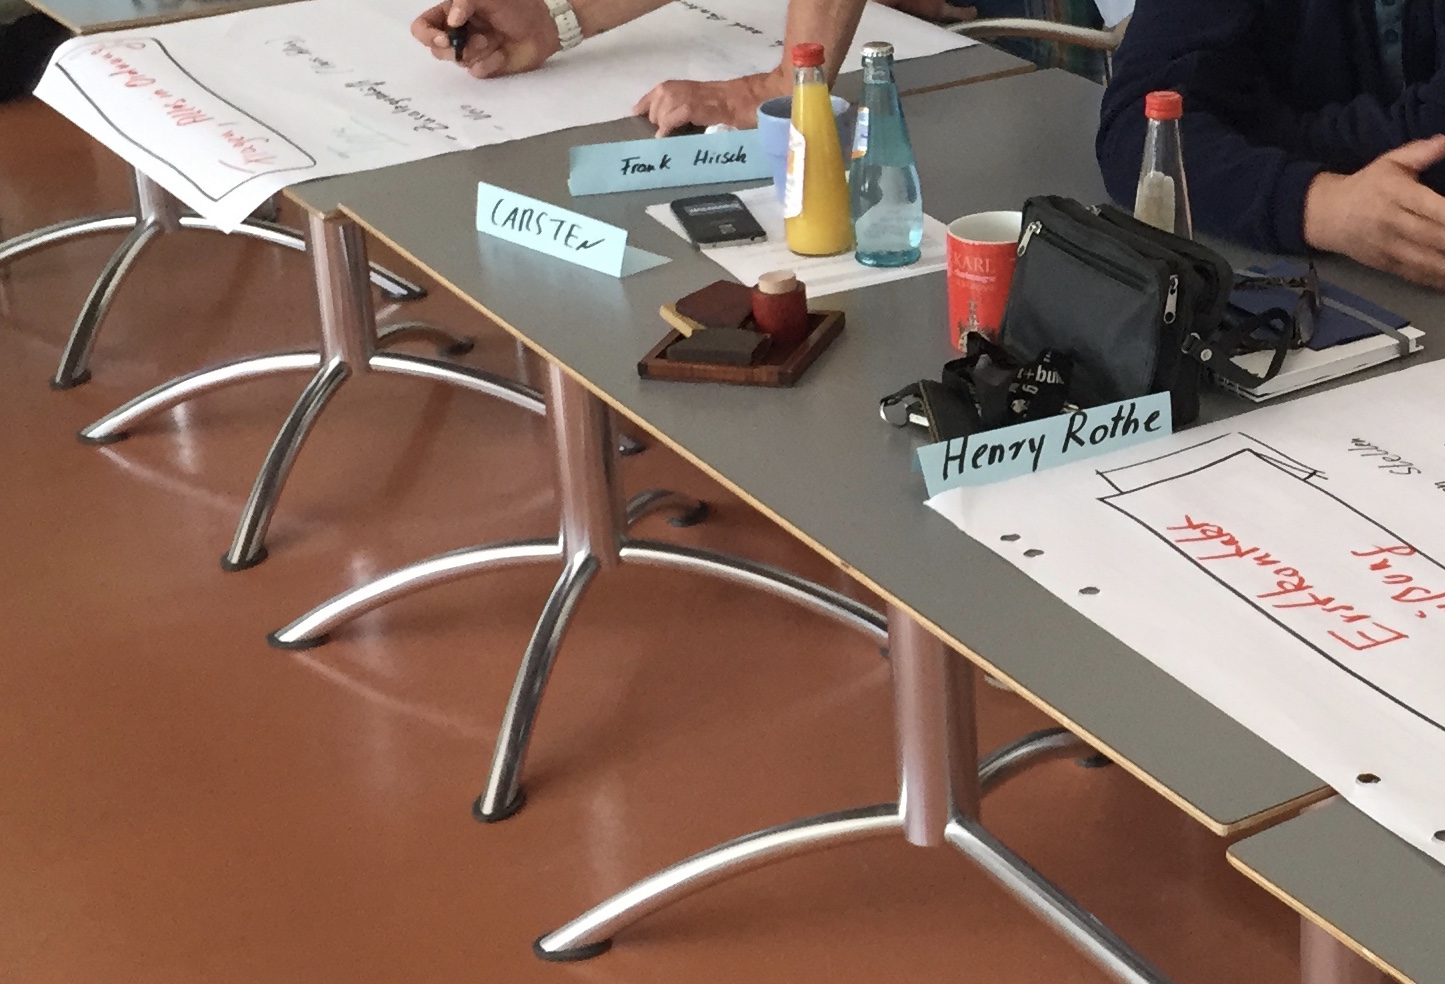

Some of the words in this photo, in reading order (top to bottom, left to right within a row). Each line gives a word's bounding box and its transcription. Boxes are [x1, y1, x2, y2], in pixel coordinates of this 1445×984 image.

[621, 154, 671, 176] Frank
[693, 146, 748, 166] Hirsch
[943, 434, 1046, 481] Henry
[1062, 402, 1161, 453] Rothe
[1348, 437, 1422, 474] Stellen
[1167, 515, 1409, 650] Erstkontakt
